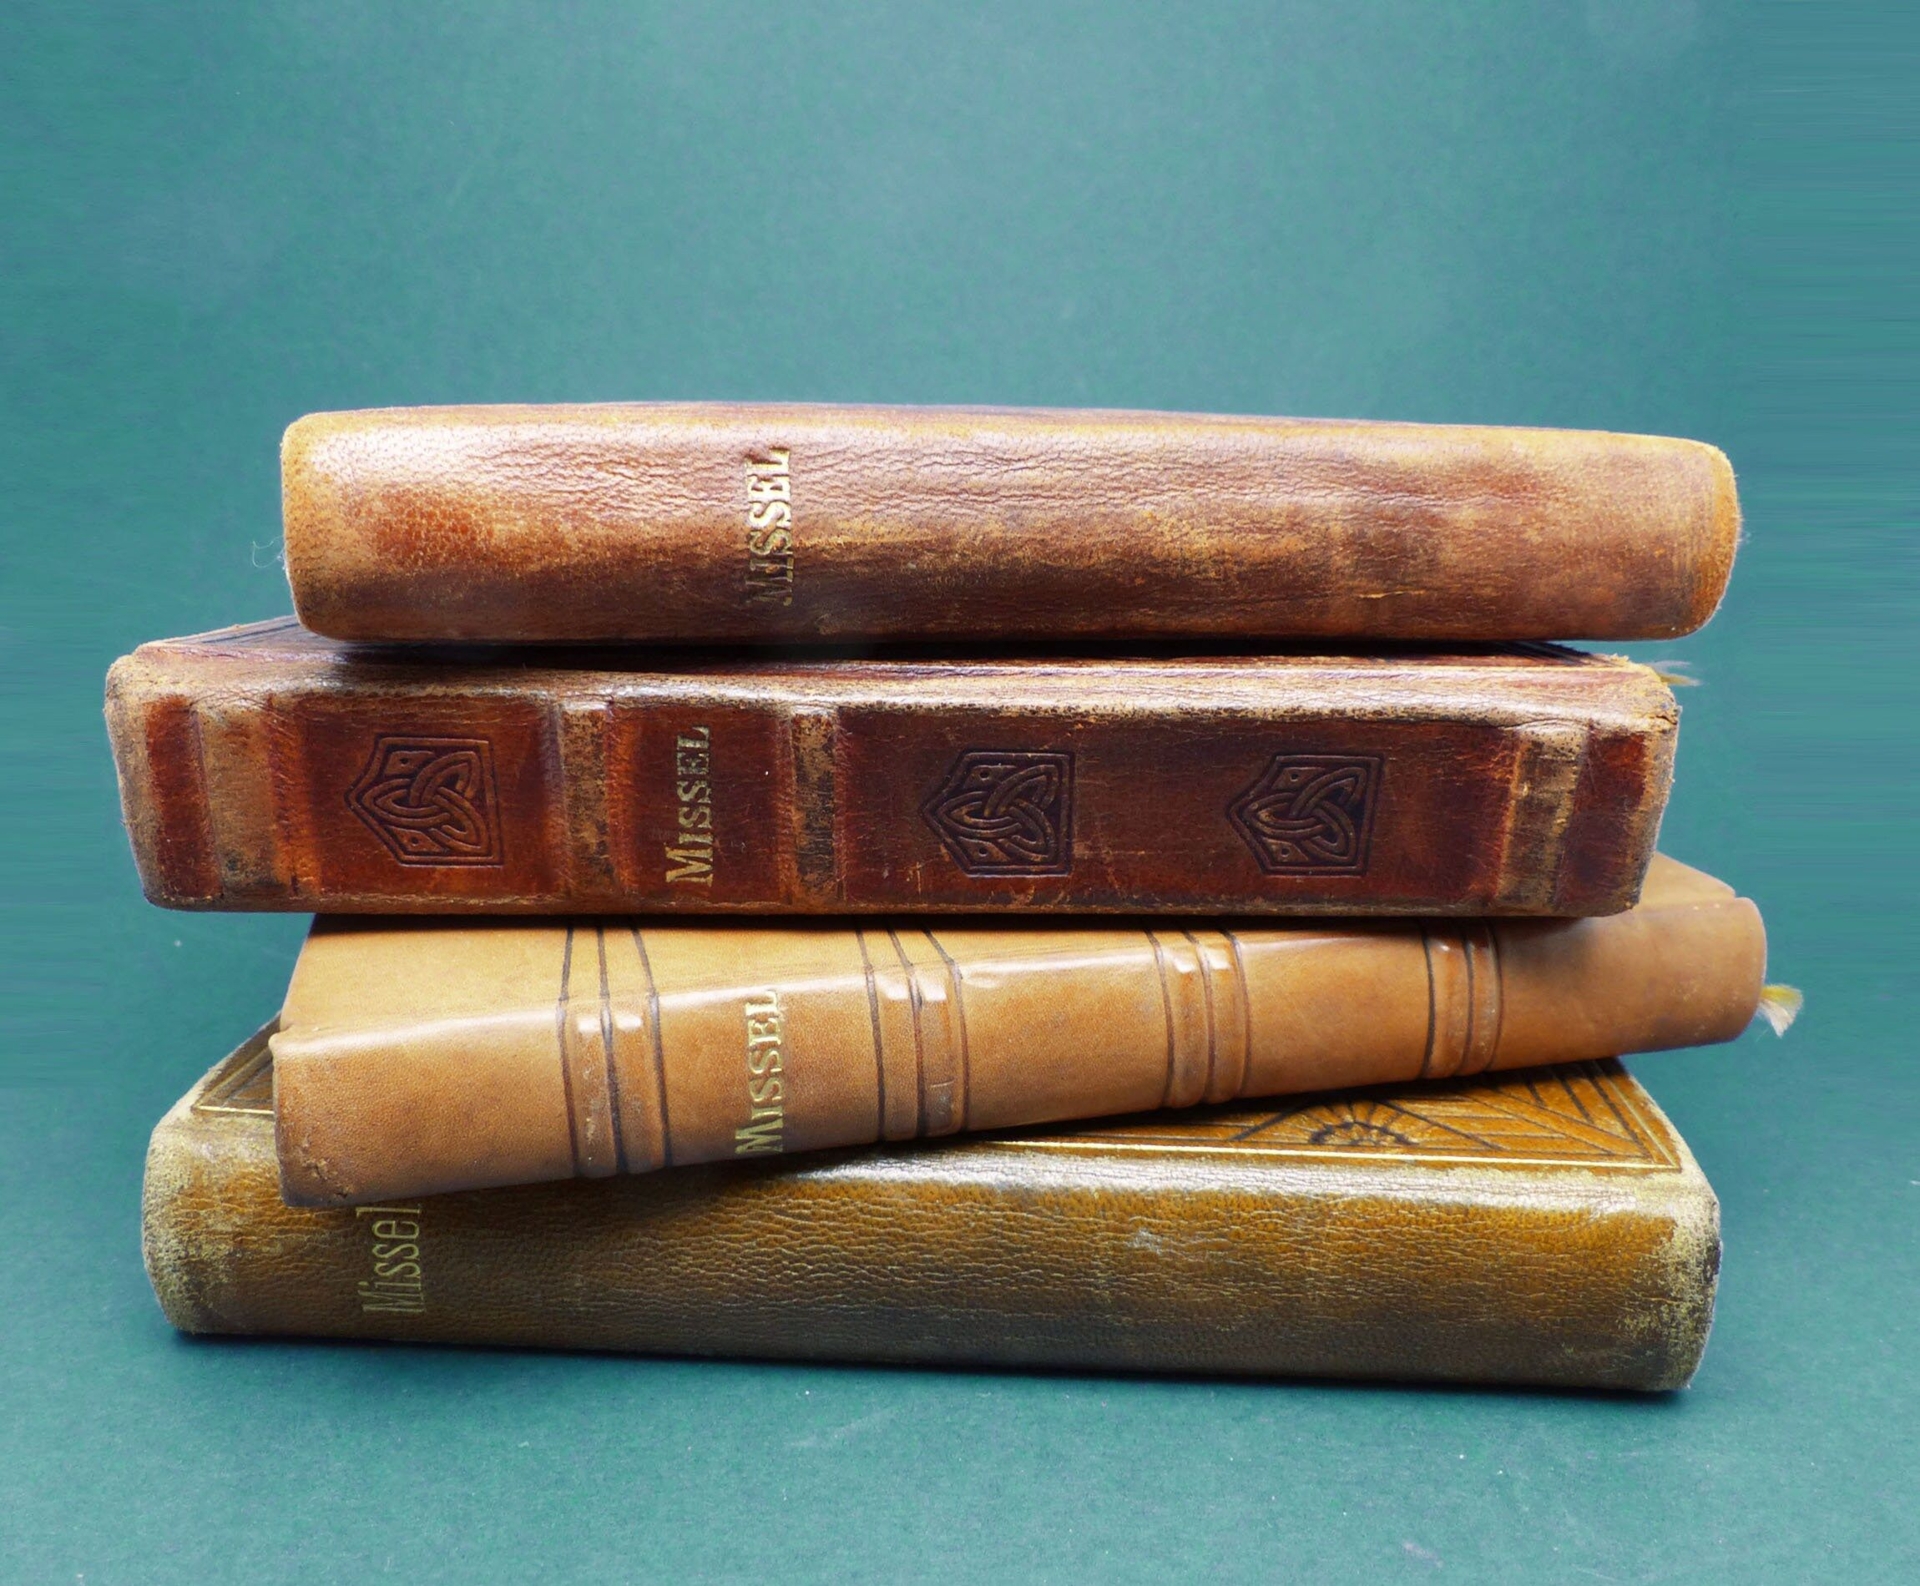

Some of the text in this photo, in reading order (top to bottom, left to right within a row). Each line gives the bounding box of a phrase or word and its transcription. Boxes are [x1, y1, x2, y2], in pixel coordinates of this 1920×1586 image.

[744, 449, 794, 606] MISSEL
[665, 725, 714, 888] MISSEL
[734, 990, 784, 1153] MISSEL
[355, 1206, 425, 1313] Missel
